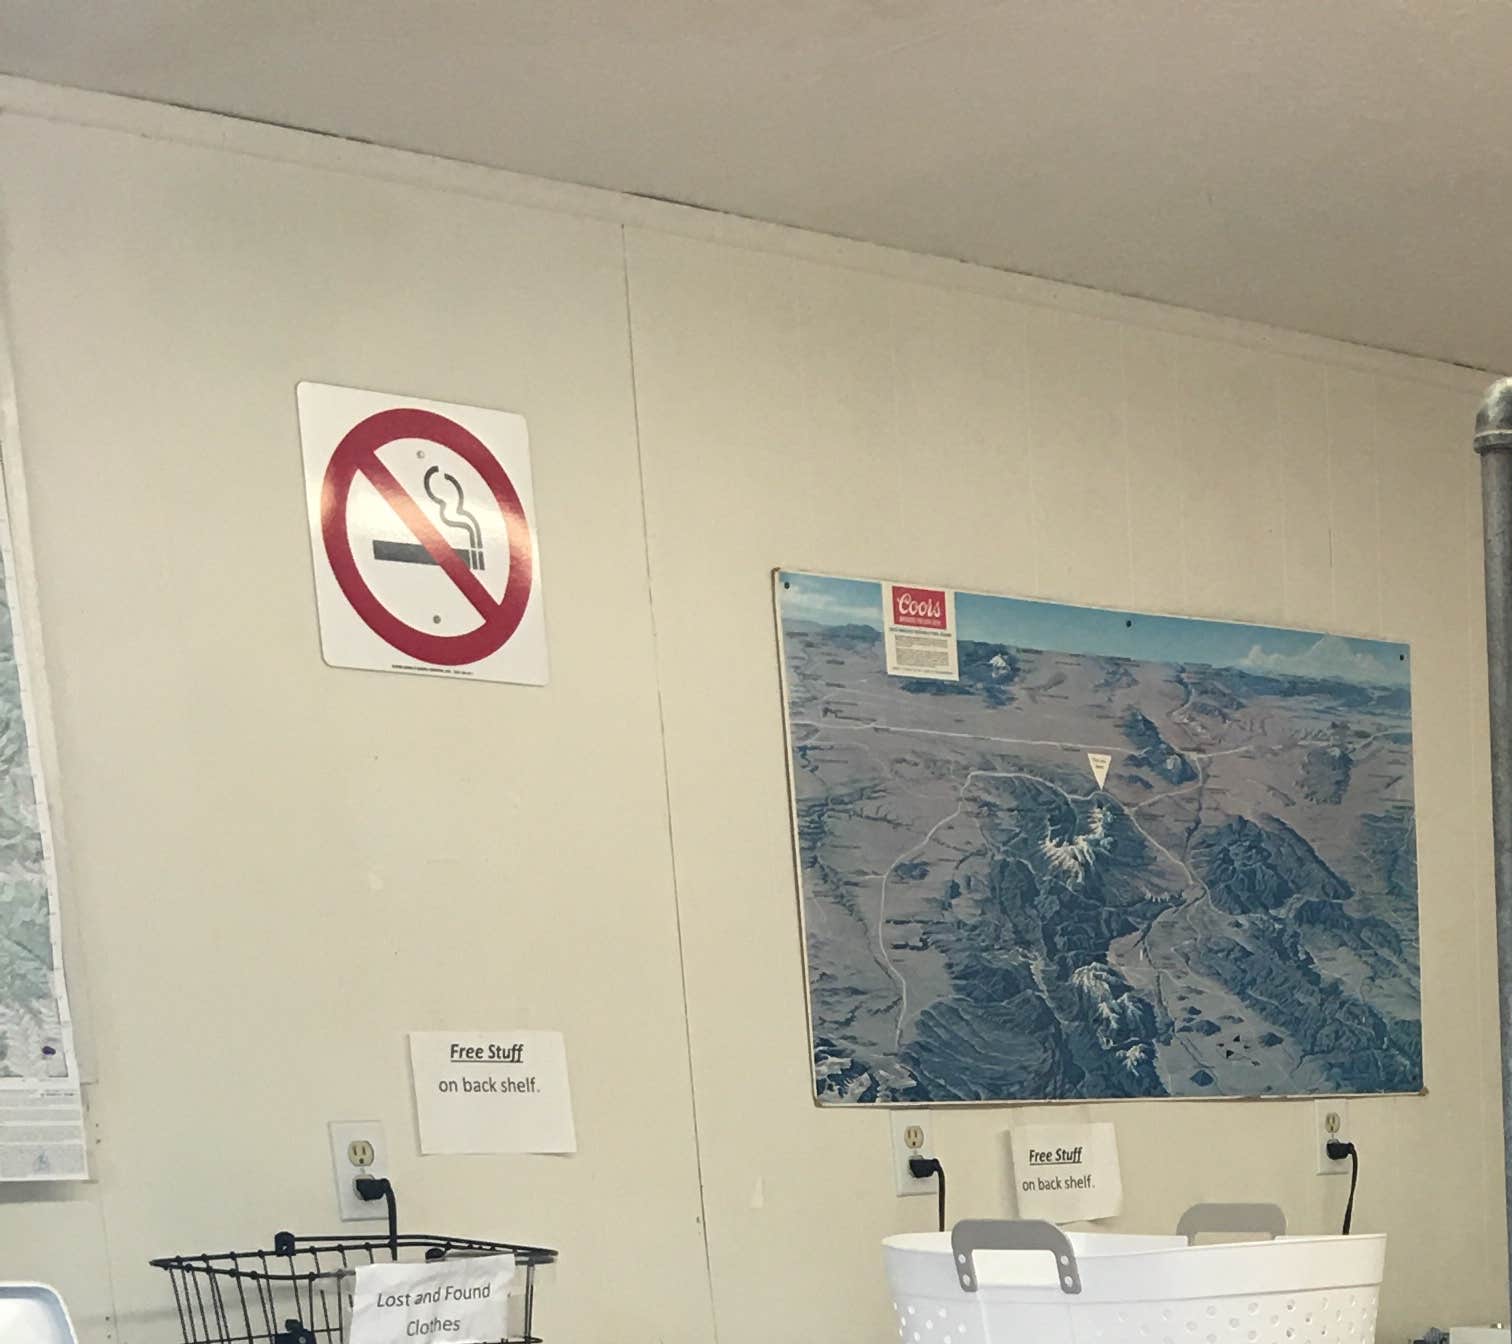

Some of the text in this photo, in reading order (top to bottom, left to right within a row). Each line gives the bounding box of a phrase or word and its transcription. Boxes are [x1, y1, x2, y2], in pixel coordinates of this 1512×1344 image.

[897, 593, 941, 617] Coors
[450, 1044, 524, 1062] Free Stuff
[438, 1077, 541, 1093] on back shelf.
[1029, 1146, 1083, 1163] Free Stuff
[1022, 1174, 1095, 1191] on back shelf.
[377, 1281, 491, 1308] Lost and Found
[406, 1316, 461, 1336] Clothes
